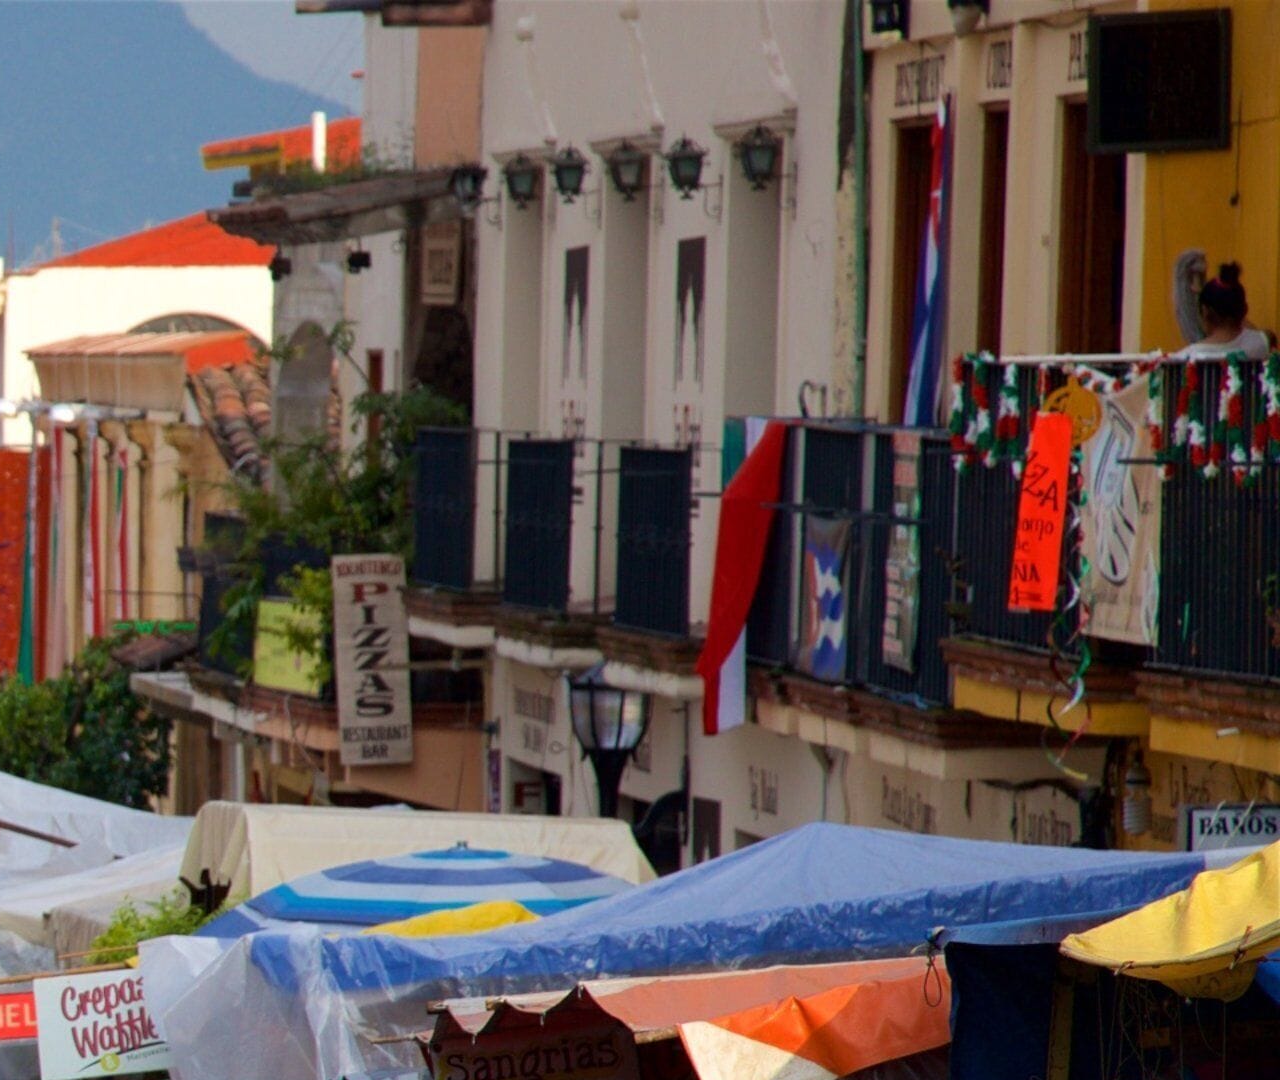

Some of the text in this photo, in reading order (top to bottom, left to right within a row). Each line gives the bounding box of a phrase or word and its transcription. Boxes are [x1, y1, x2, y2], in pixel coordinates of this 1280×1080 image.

[351, 582, 394, 717] PIZZAS
[362, 744, 389, 759] BAR
[1199, 810, 1277, 835] BAÑOS
